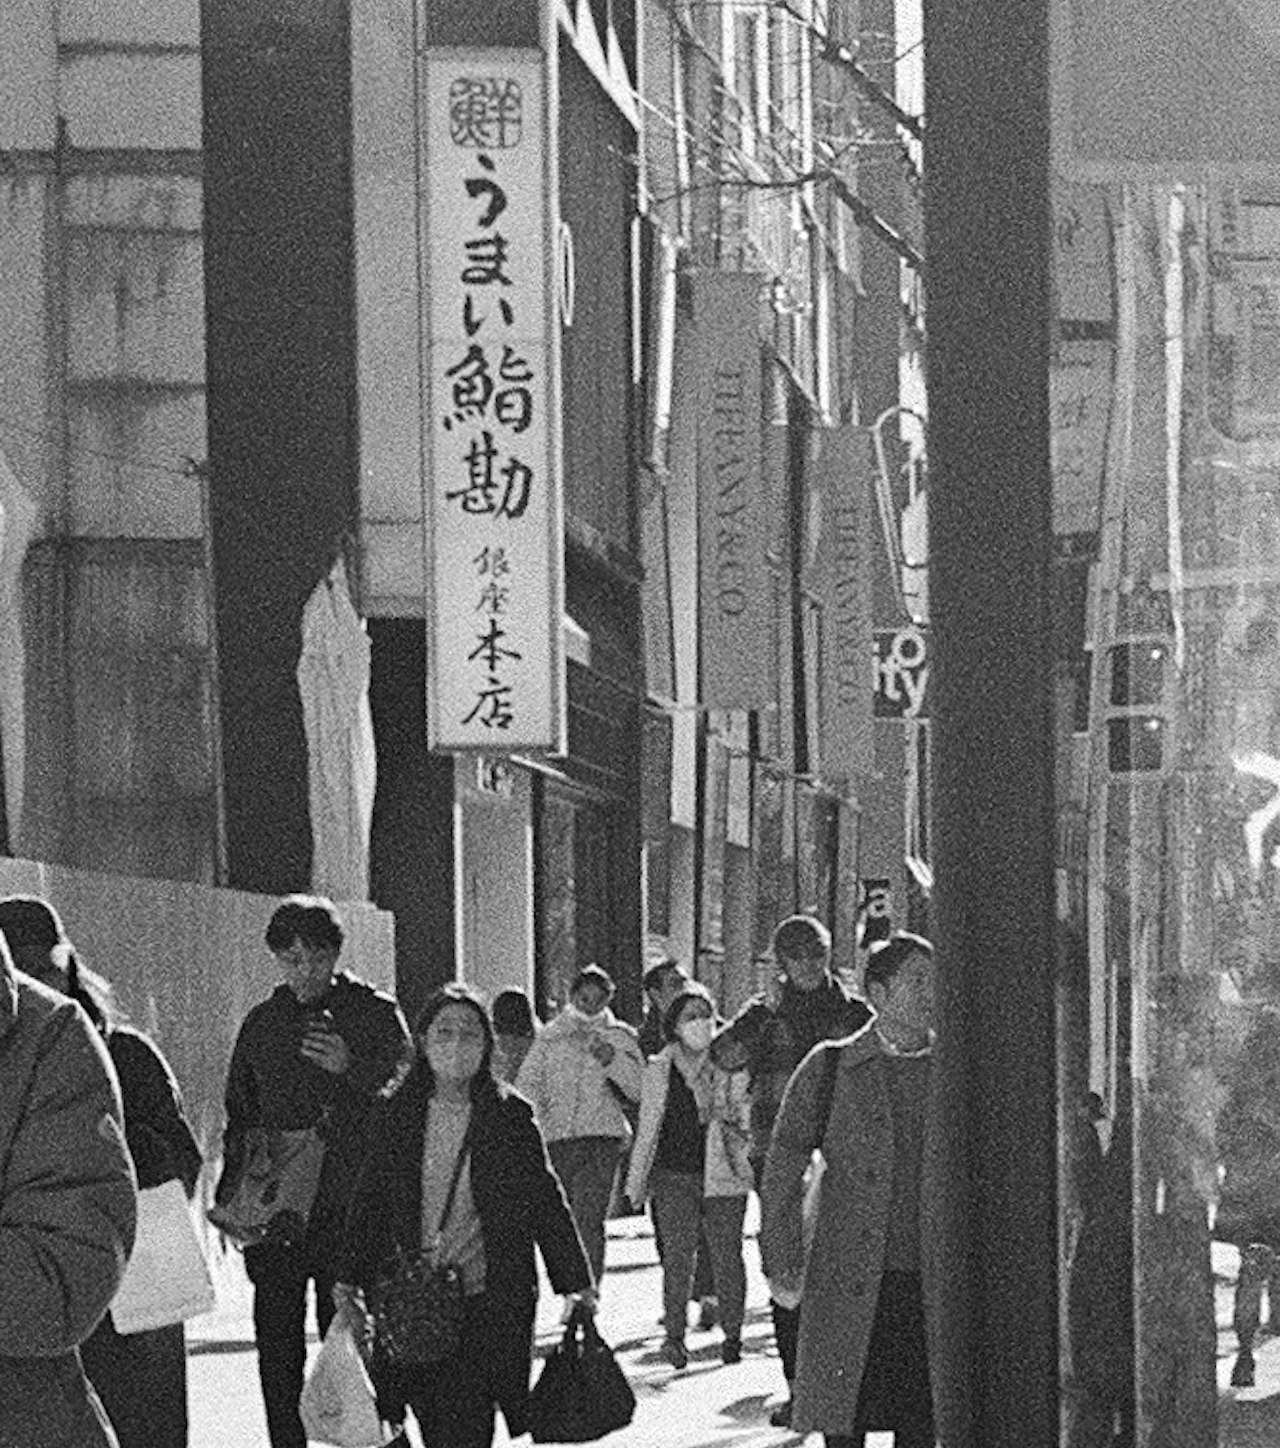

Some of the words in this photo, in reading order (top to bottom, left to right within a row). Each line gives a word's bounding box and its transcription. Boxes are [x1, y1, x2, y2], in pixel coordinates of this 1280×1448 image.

[442, 153, 534, 519] うまい鮨勘
[461, 545, 522, 730] 銀座本店
